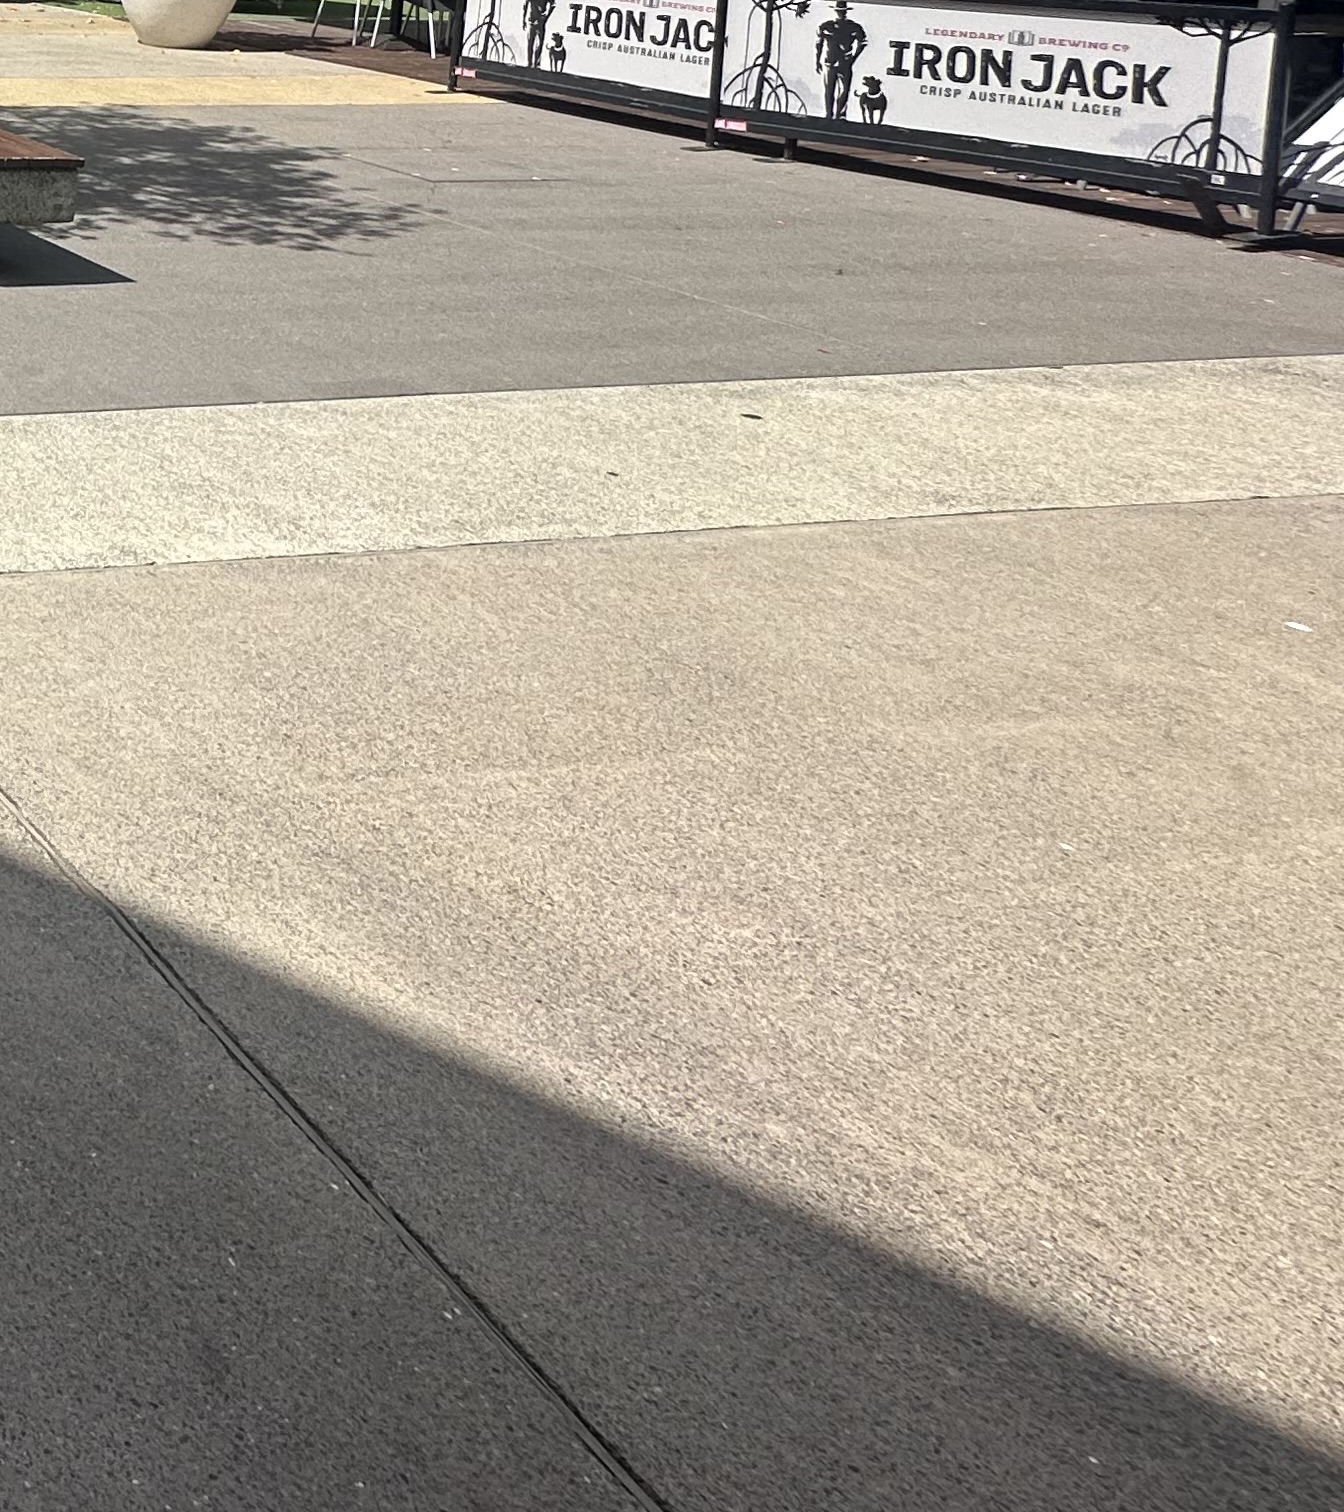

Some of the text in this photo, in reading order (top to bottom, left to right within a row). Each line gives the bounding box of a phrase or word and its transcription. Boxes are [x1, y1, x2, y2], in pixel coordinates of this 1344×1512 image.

[661, 1, 705, 12] BREWING
[566, 3, 715, 52] IRON JAC
[925, 27, 1005, 42] LEGENDARY
[1038, 37, 1109, 50] BREWING
[587, 40, 710, 66] CRISP AUSTRALIAN LAGER
[886, 40, 1172, 107] IRON JACK
[919, 84, 1123, 117] CRISP AUSTRALIAN LAGER
